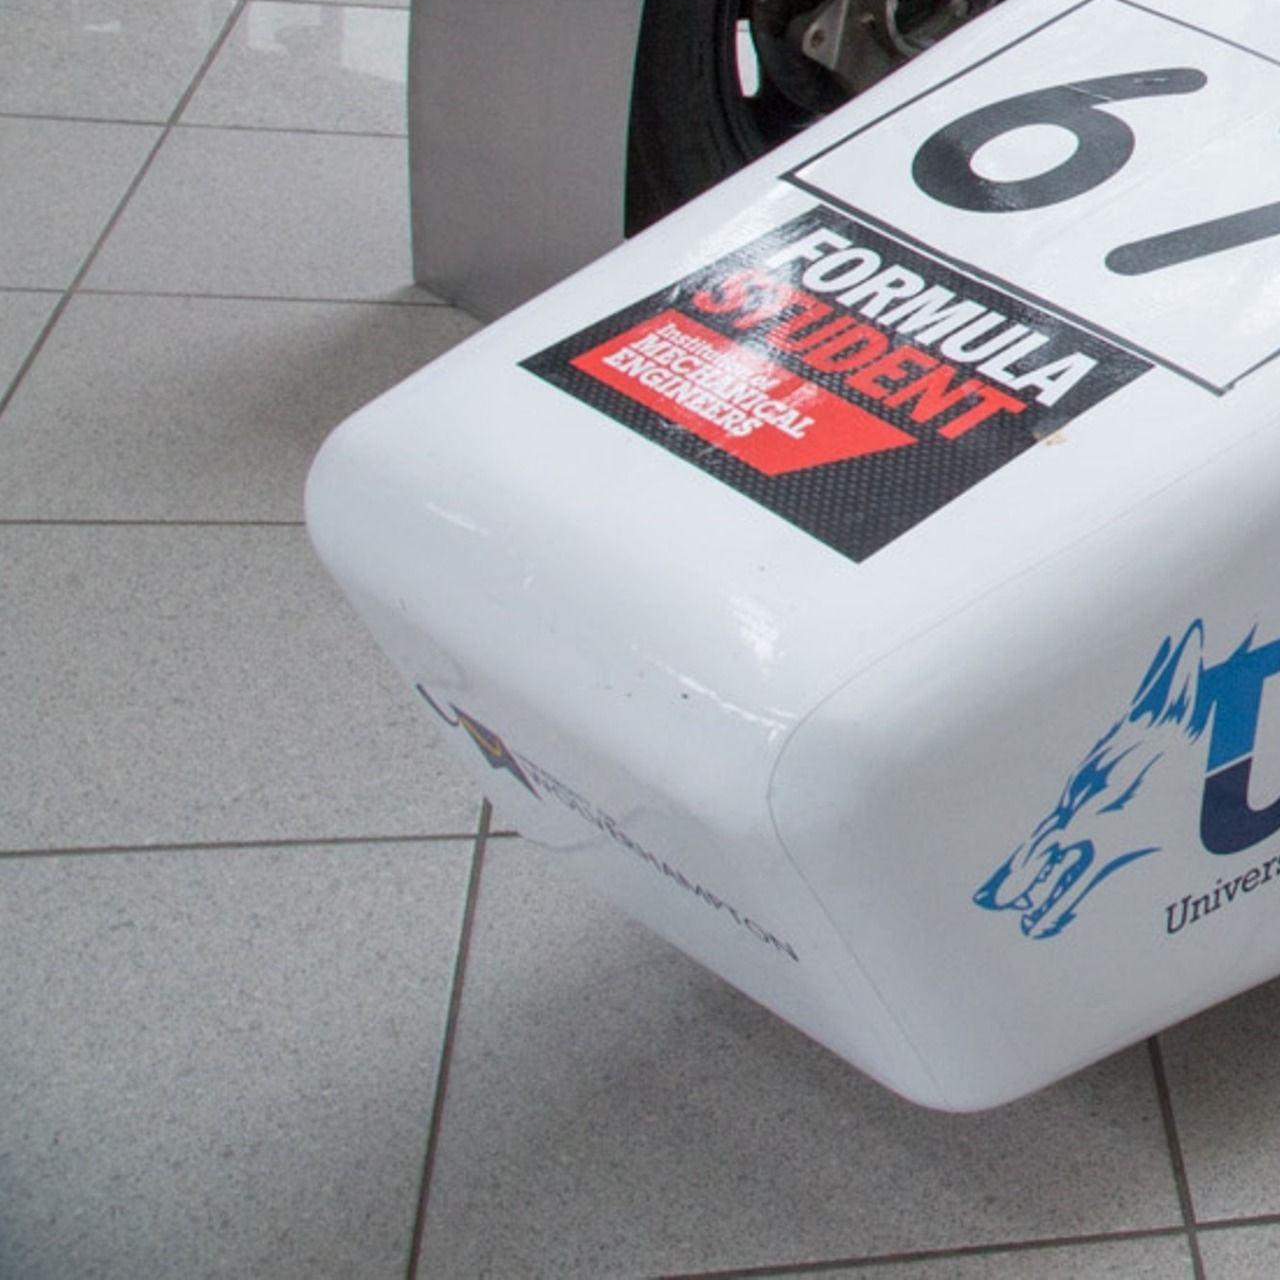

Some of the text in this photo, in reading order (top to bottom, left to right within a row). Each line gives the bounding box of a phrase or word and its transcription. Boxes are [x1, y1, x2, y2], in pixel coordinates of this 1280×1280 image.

[631, 332, 816, 440] MECHANICAL
[691, 265, 1030, 443] STUDENT
[767, 226, 1099, 409] FORMULA
[601, 346, 764, 439] ENGINEERS
